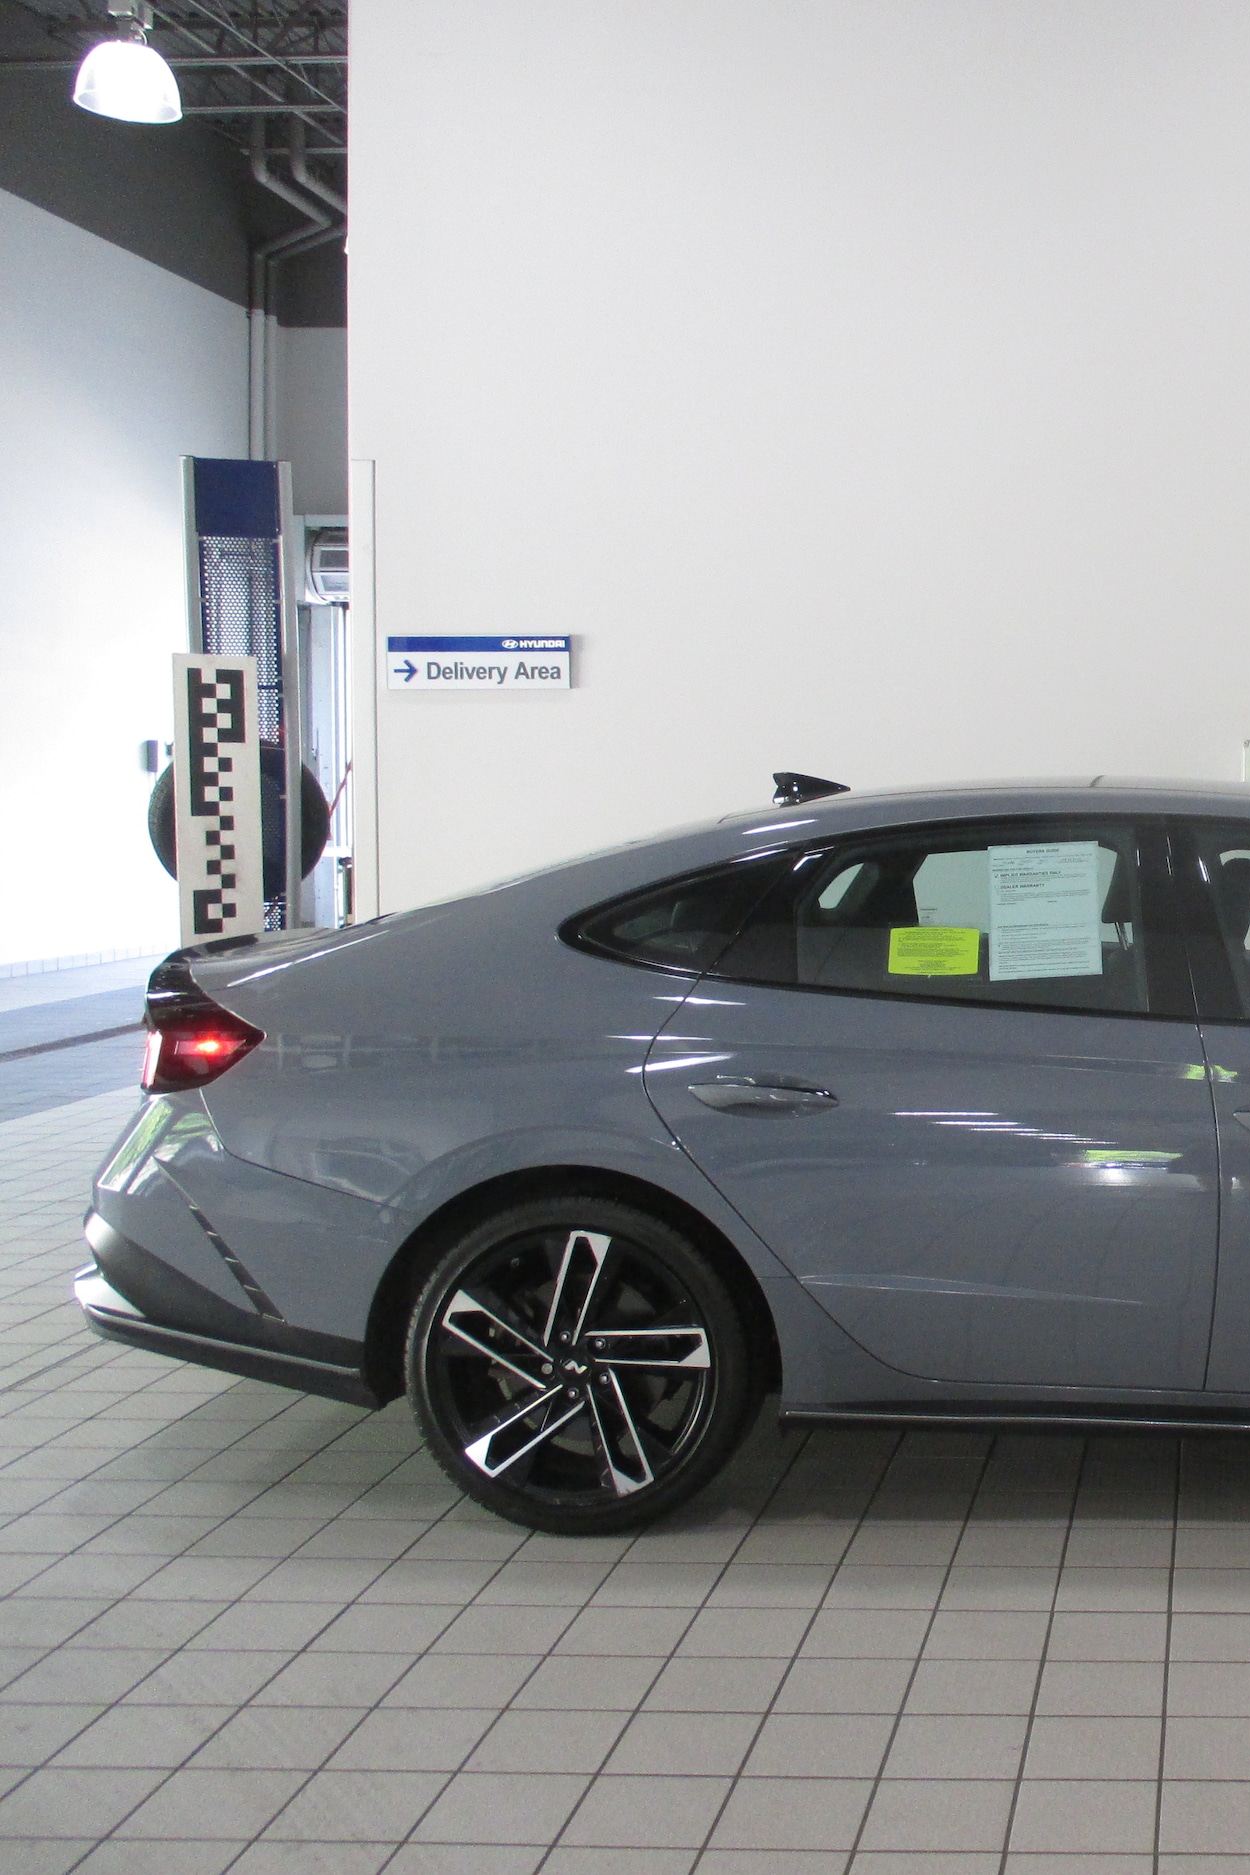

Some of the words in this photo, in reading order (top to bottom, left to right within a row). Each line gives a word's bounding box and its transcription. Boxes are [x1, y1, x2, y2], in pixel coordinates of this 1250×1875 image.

[520, 640, 566, 648] HYUNDAI
[427, 661, 508, 685] Delivery
[514, 661, 561, 680] Area
